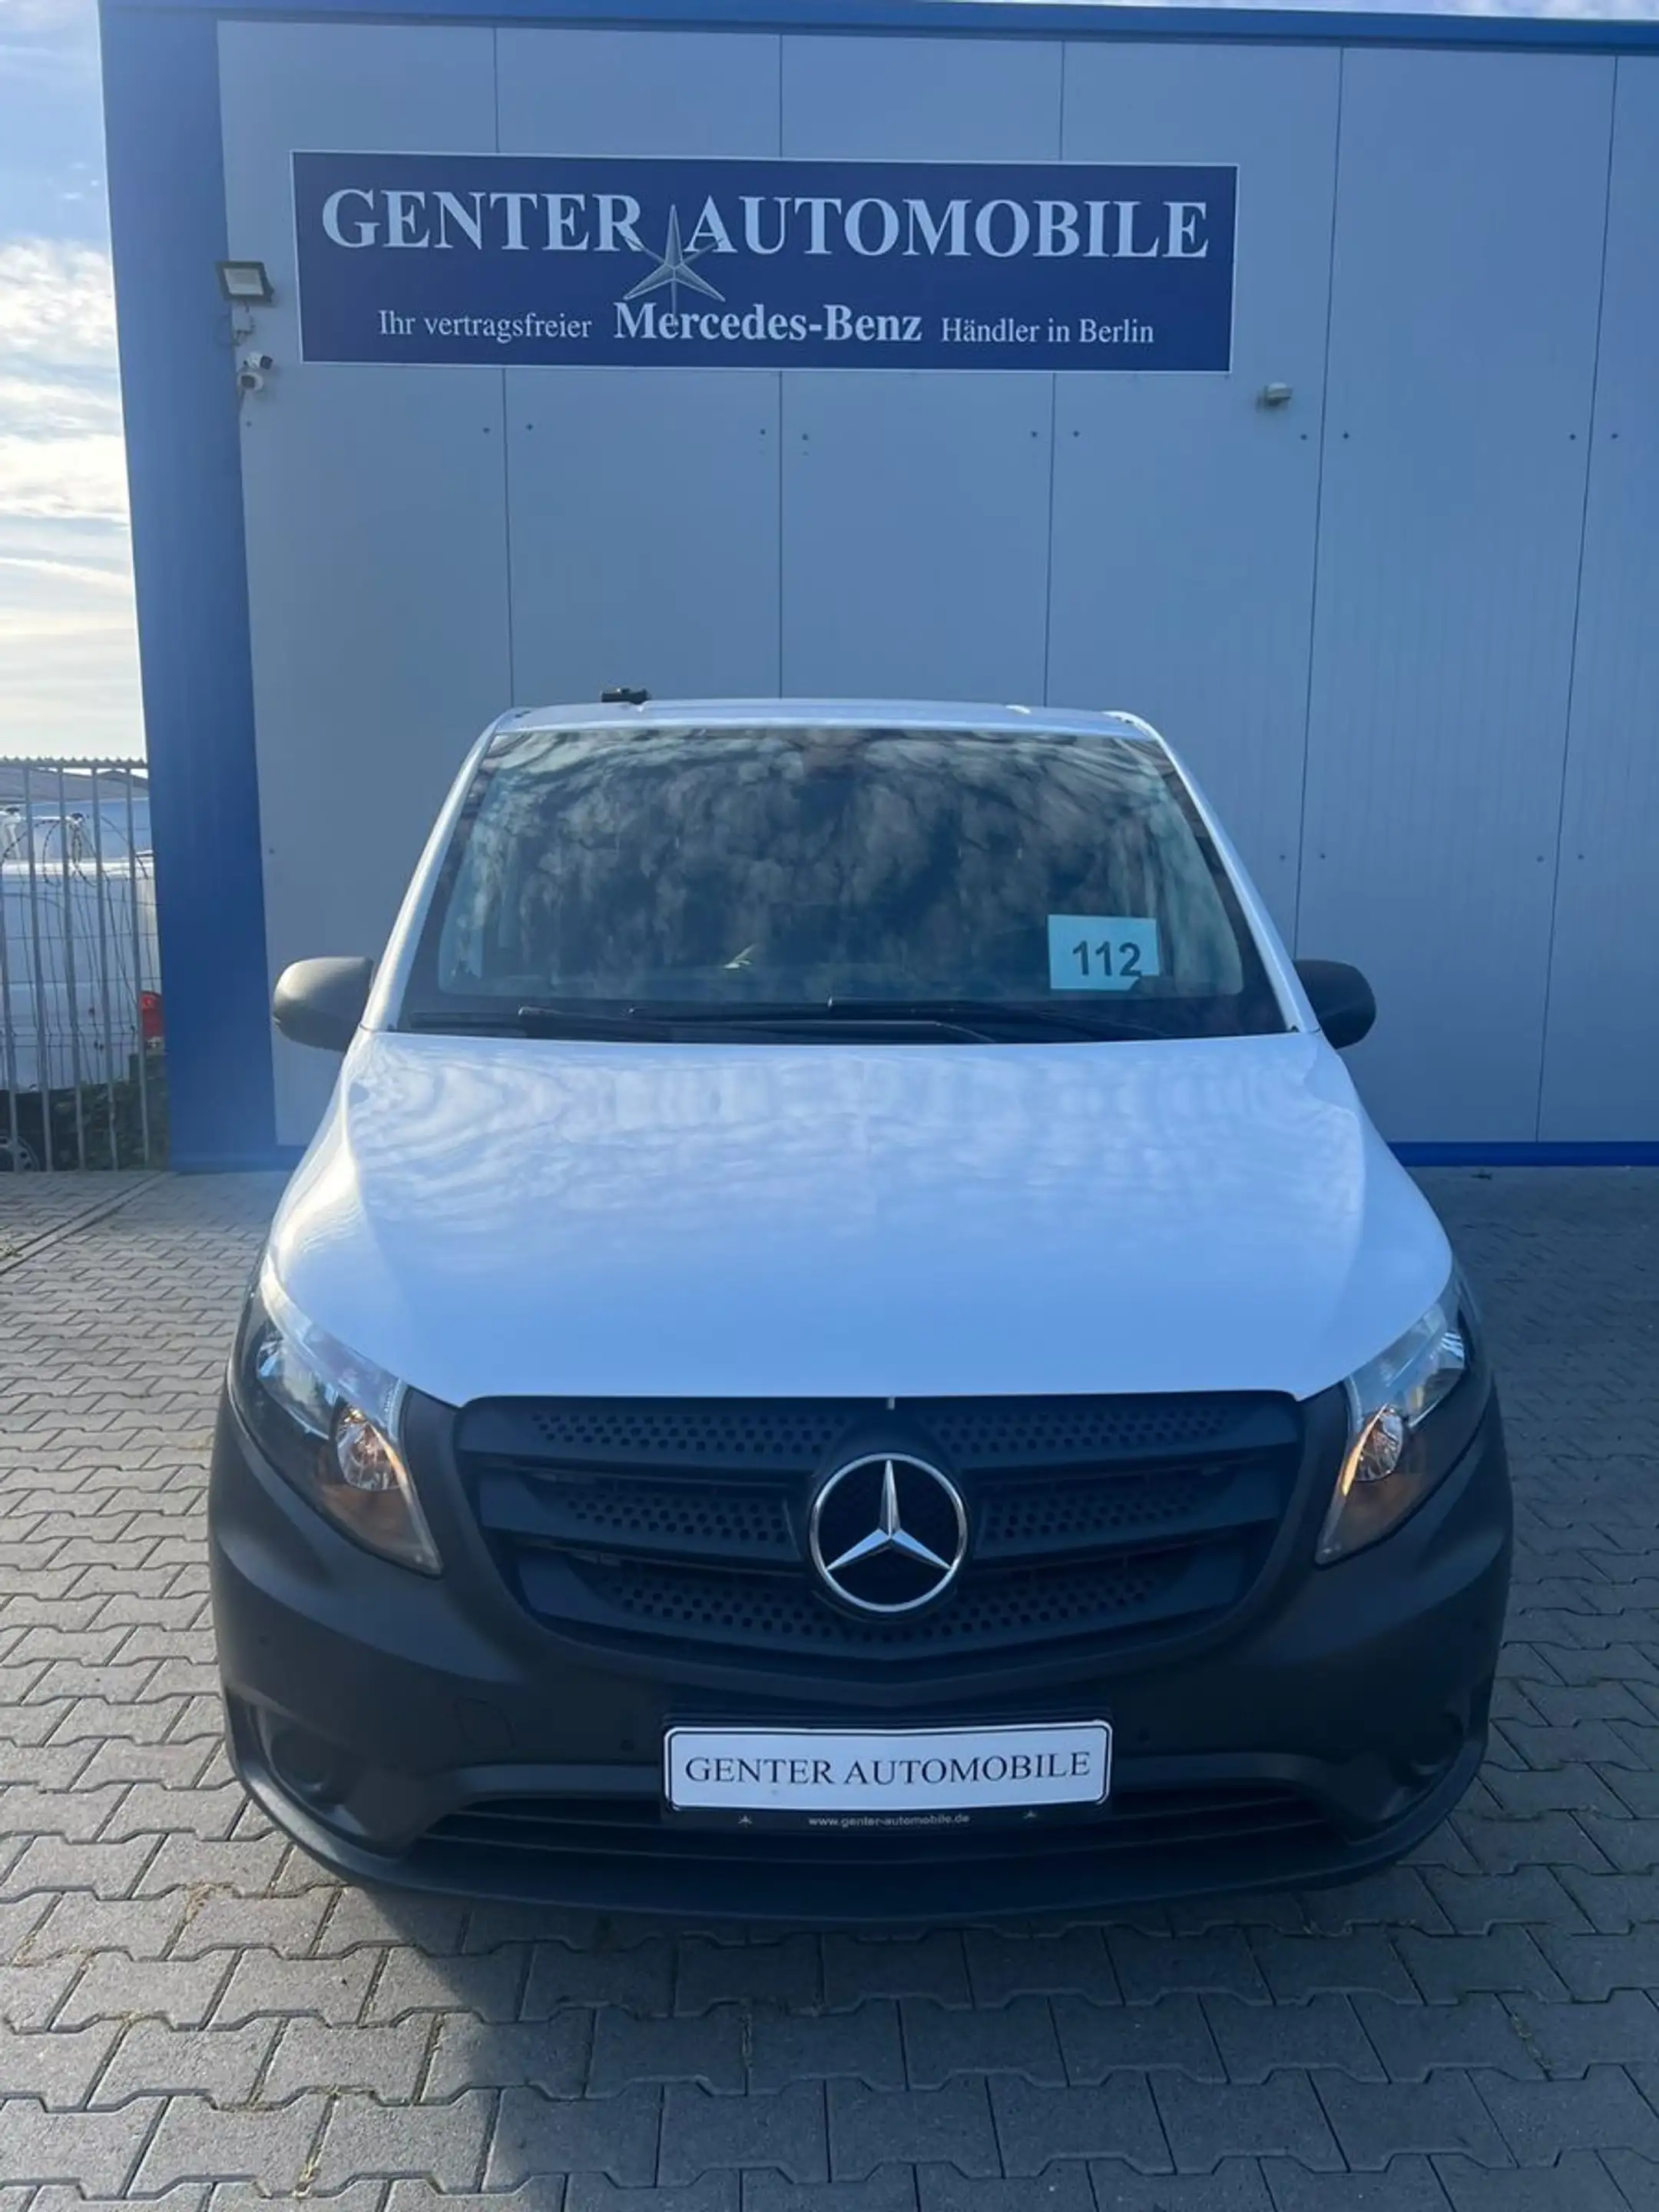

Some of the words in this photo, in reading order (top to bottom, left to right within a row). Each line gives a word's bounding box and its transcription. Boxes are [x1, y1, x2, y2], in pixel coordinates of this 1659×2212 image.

[323, 188, 641, 252] GENTER
[685, 194, 1208, 257] AUTOMOBILE
[379, 310, 415, 336] Ihr
[425, 312, 591, 343] vertragsfreier
[614, 302, 922, 340] Mercedes-Benz
[942, 318, 1040, 343] Händler
[1048, 318, 1069, 343] in
[1078, 320, 1153, 344] Berlin
[1072, 940, 1141, 976] 112
[685, 1757, 833, 1785] GENTER
[843, 1751, 1091, 1786] AUTOMOBILE
[809, 1813, 970, 1828] www.genter-automobile.de
